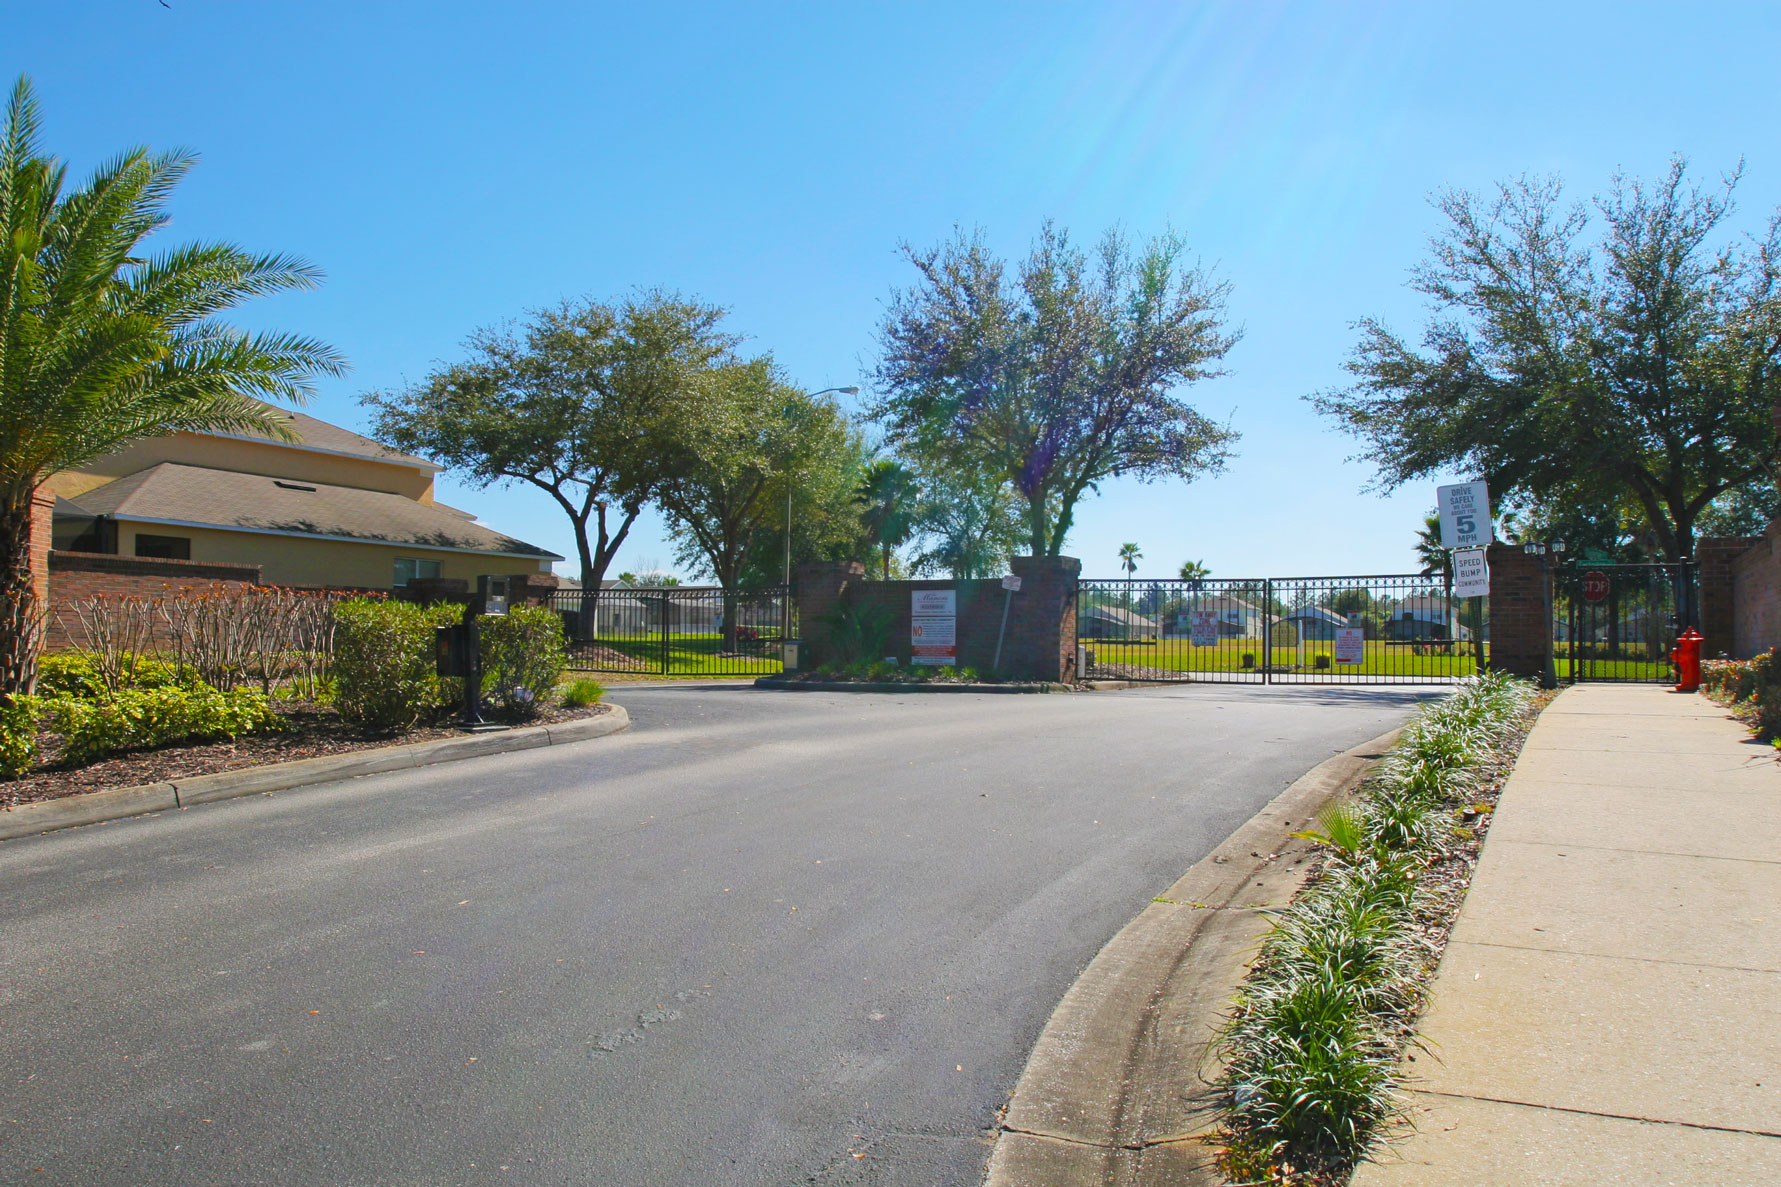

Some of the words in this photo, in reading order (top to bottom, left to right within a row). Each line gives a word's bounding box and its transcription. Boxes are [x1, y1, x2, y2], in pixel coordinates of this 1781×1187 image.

[1451, 486, 1472, 496] DRIVE
[1450, 495, 1475, 505] SAFELY
[1457, 515, 1476, 534] 5
[1458, 534, 1477, 543] MPH
[1458, 558, 1481, 568] SPEED
[1460, 568, 1481, 577] BUMP
[1458, 579, 1485, 588] COMMUNITY
[912, 625, 923, 637] NO
